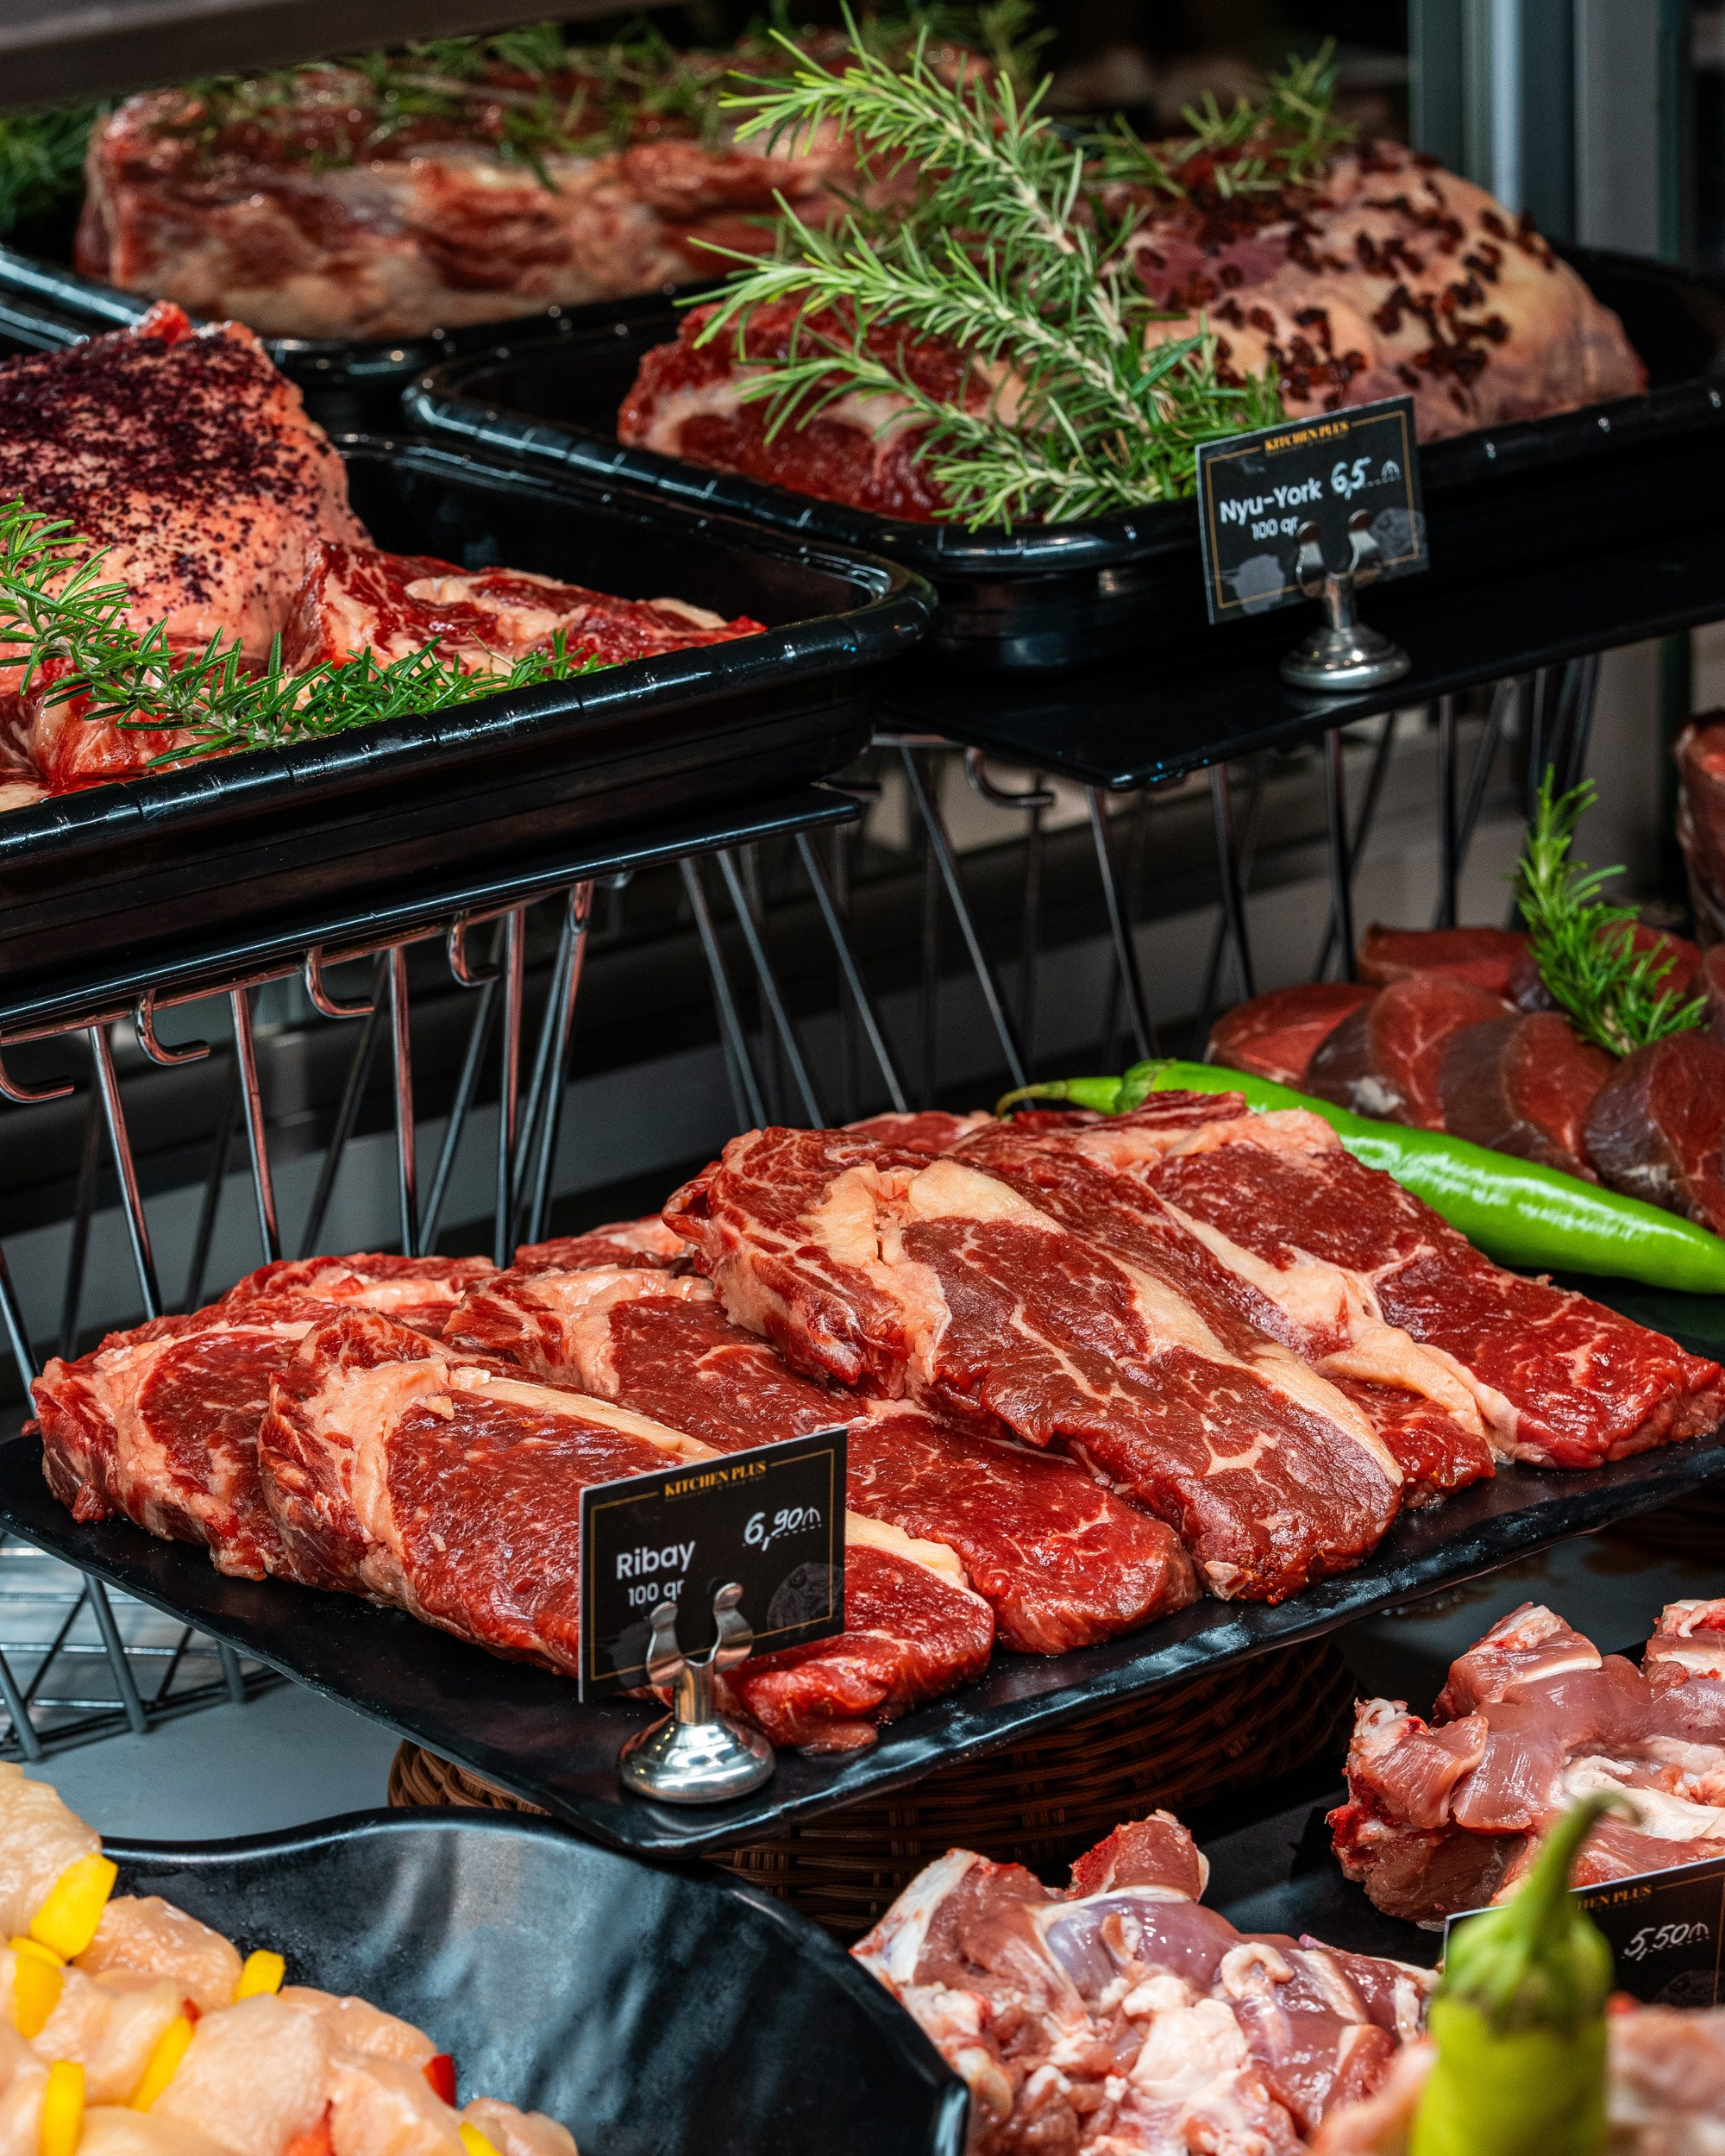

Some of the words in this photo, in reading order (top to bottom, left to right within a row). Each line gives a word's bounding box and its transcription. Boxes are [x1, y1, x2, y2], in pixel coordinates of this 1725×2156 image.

[1220, 478, 1323, 525] Nyu-York
[1251, 521, 1279, 541] 100
[664, 1470, 729, 1497] KITCHEN
[731, 1460, 767, 1481] PLUS
[616, 1540, 696, 1580] Ribay
[628, 1582, 659, 1608] 100
[1613, 1884, 1652, 1903] PLUS
